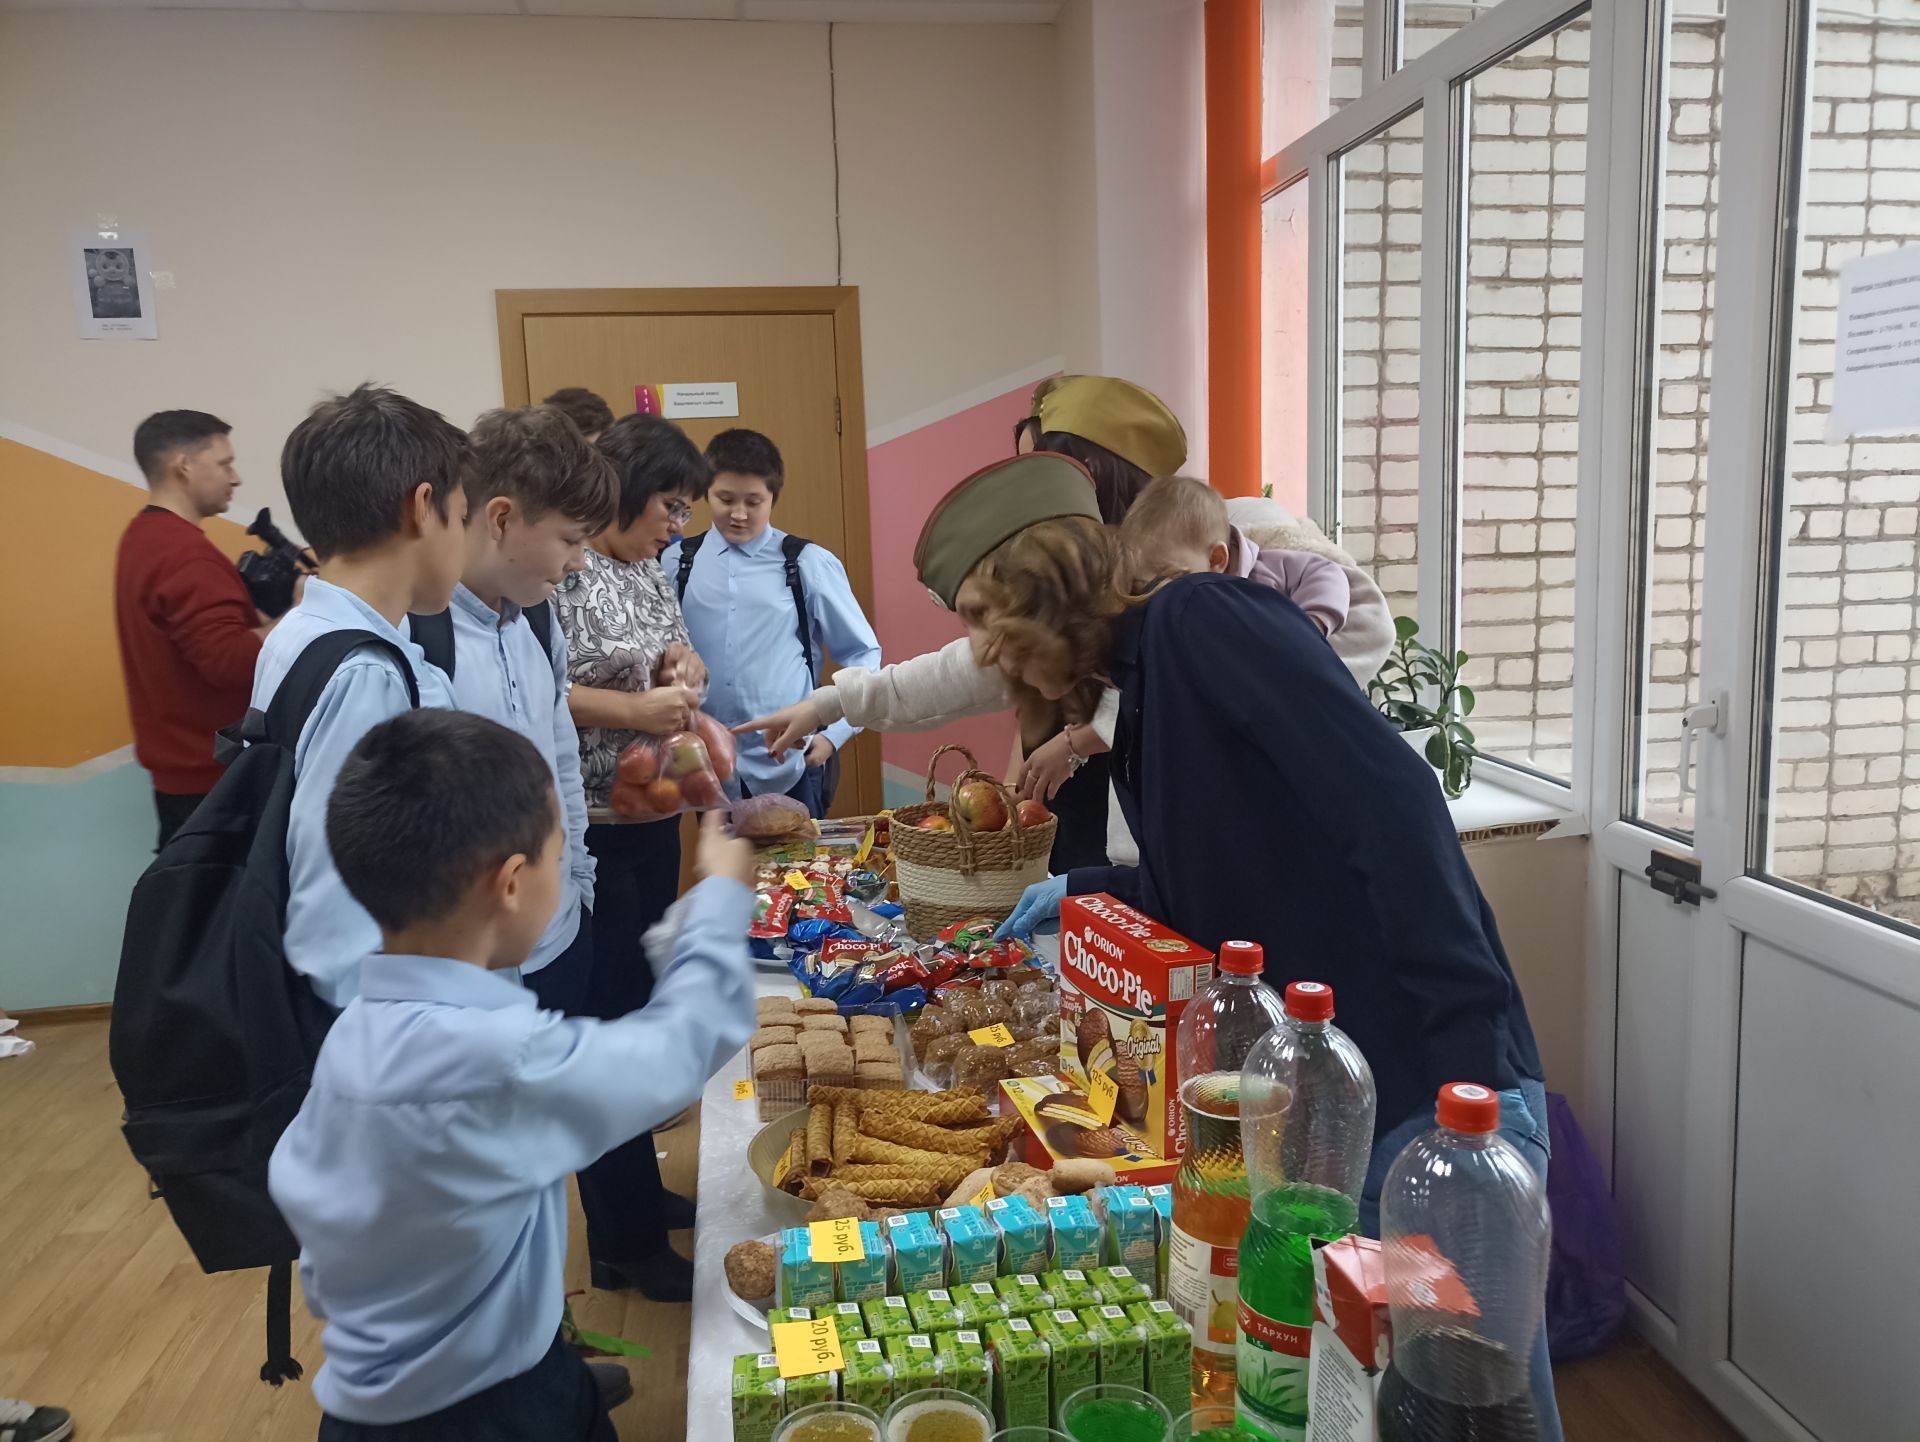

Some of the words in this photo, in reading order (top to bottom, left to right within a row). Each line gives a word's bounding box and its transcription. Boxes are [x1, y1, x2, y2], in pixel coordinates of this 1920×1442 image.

[1093, 933, 1122, 961] ORION
[1127, 1033, 1161, 1060] Original
[1168, 1099, 1176, 1127] ORION
[834, 1218, 850, 1231] 25
[811, 1320, 829, 1335] 20
[1256, 1322, 1298, 1343] ТАРХУН
